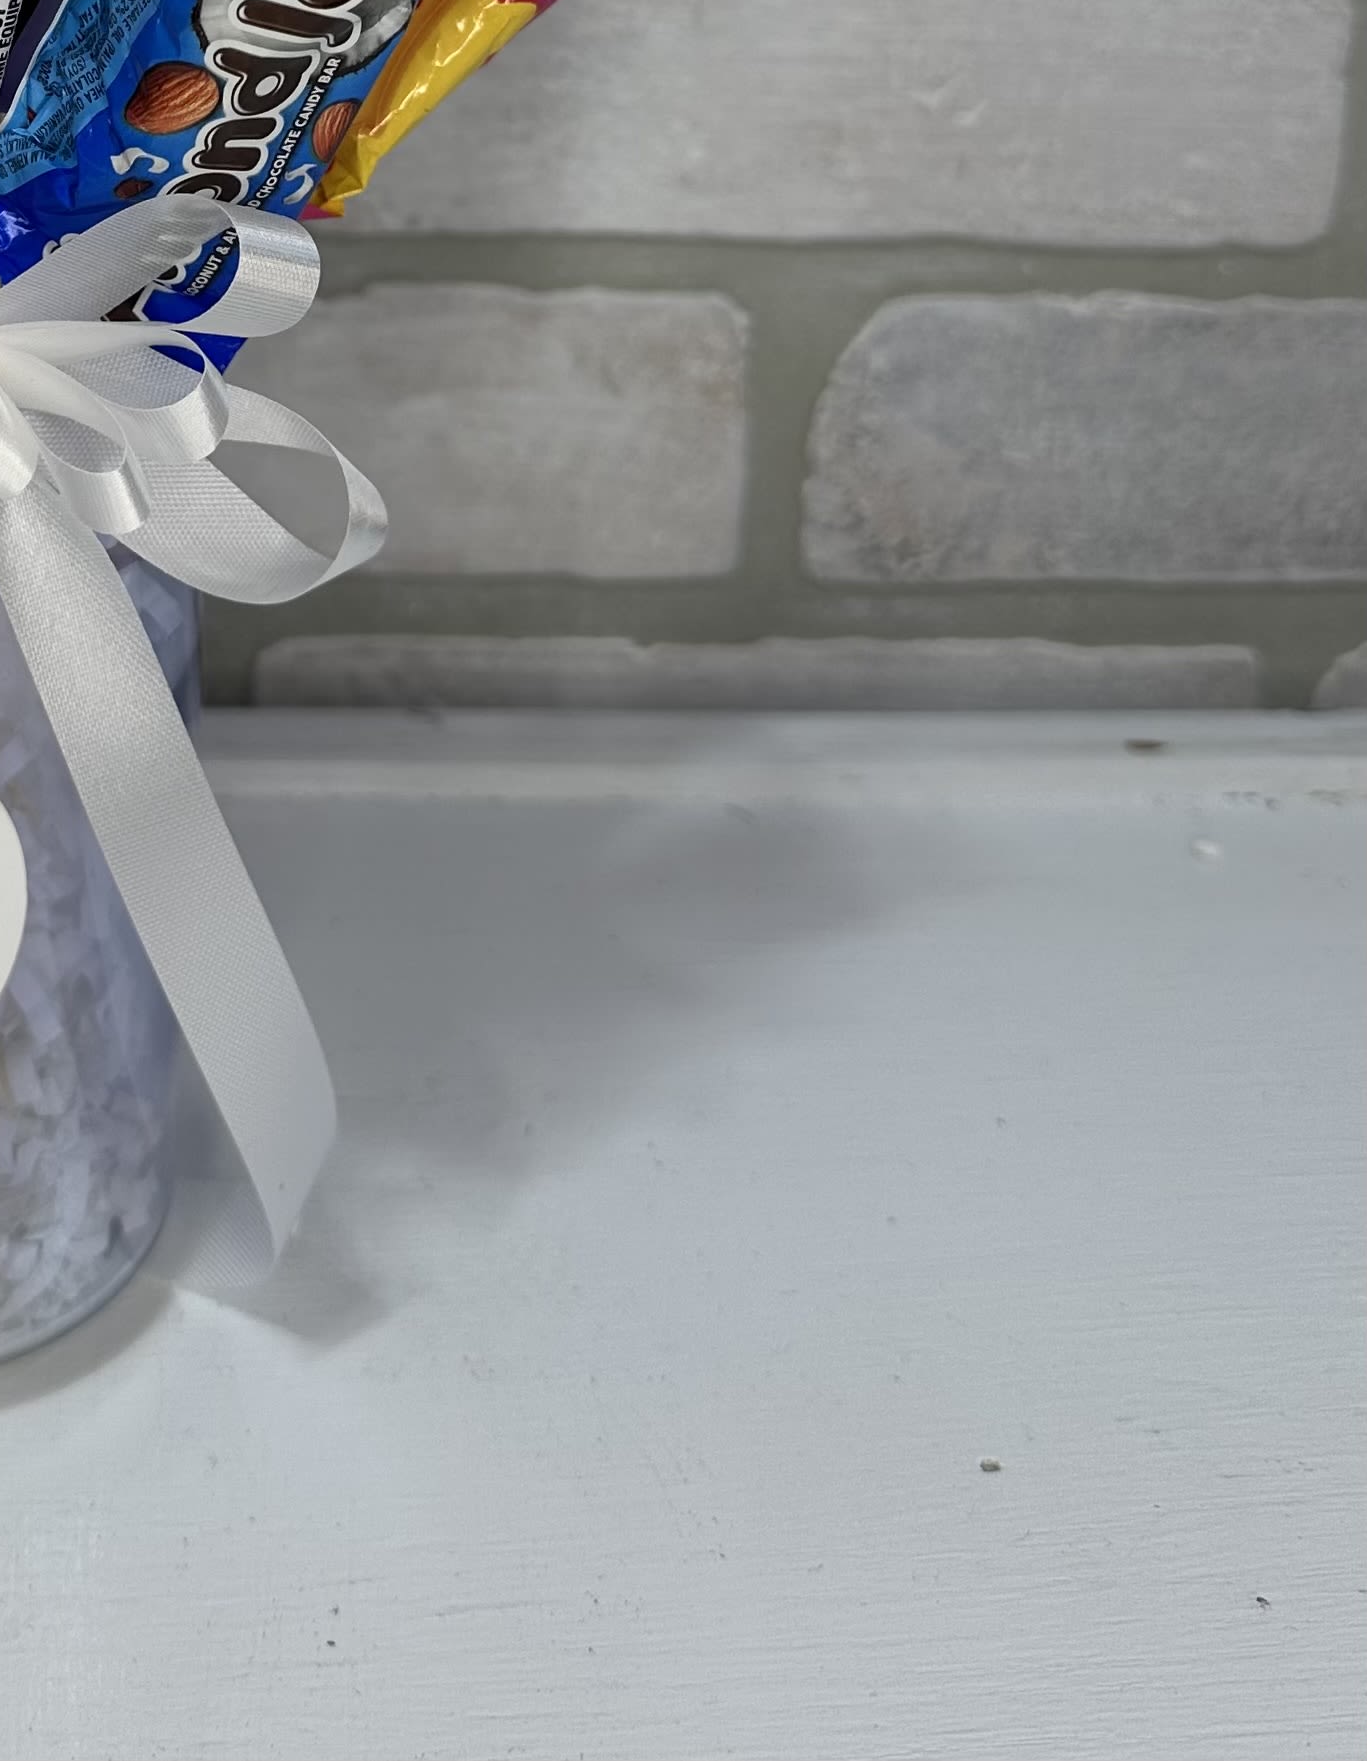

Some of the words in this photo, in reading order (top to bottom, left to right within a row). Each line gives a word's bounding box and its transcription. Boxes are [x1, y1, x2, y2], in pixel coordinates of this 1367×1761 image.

[217, 242, 231, 256] &
[256, 128, 302, 200] CHOCOLATE
[295, 85, 324, 129] CANDY
[319, 55, 341, 85] BAR
